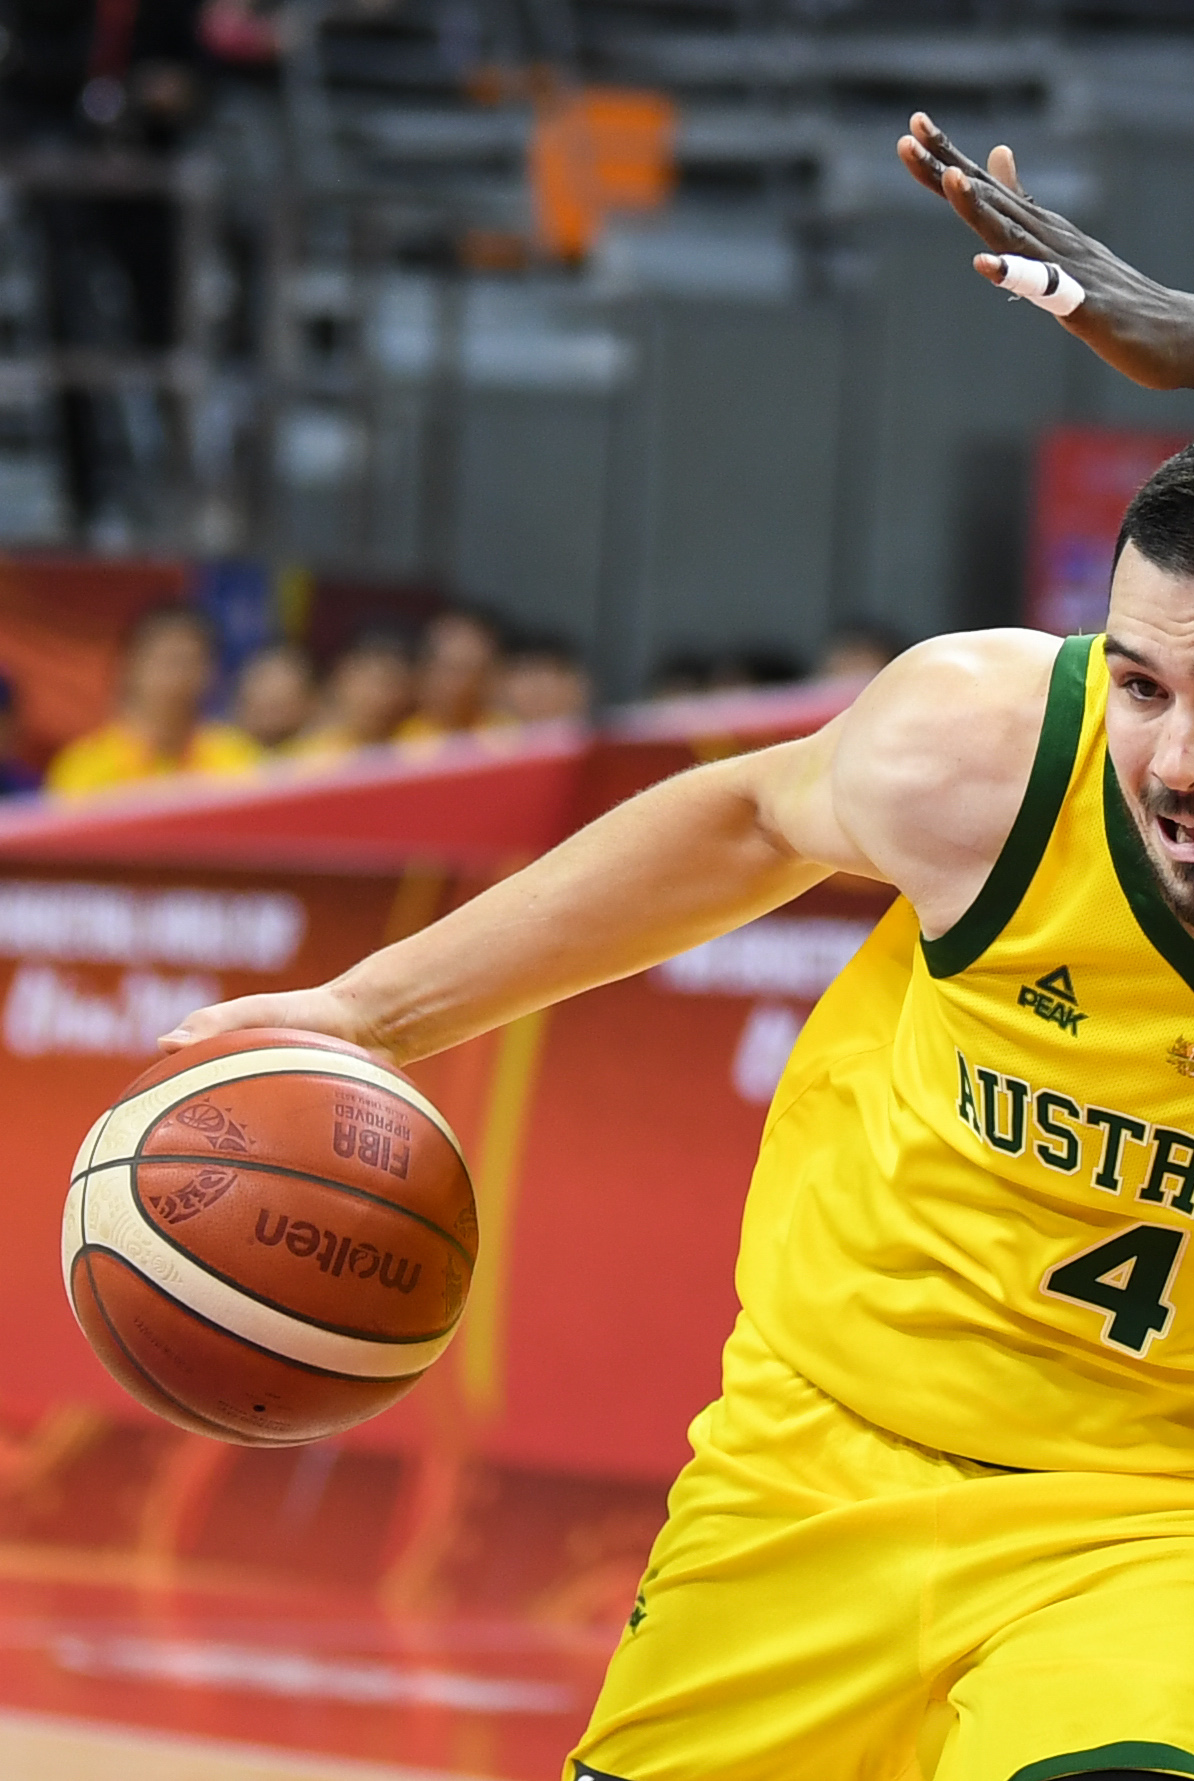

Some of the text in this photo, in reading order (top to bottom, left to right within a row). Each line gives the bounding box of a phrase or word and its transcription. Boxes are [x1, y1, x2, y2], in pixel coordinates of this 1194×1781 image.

[1017, 985, 1089, 1038] PEAK
[333, 1120, 410, 1180] FIBA
[334, 1103, 411, 1141] APPROVED
[255, 1208, 422, 1294] molten
[1039, 1221, 1192, 1360] 4
